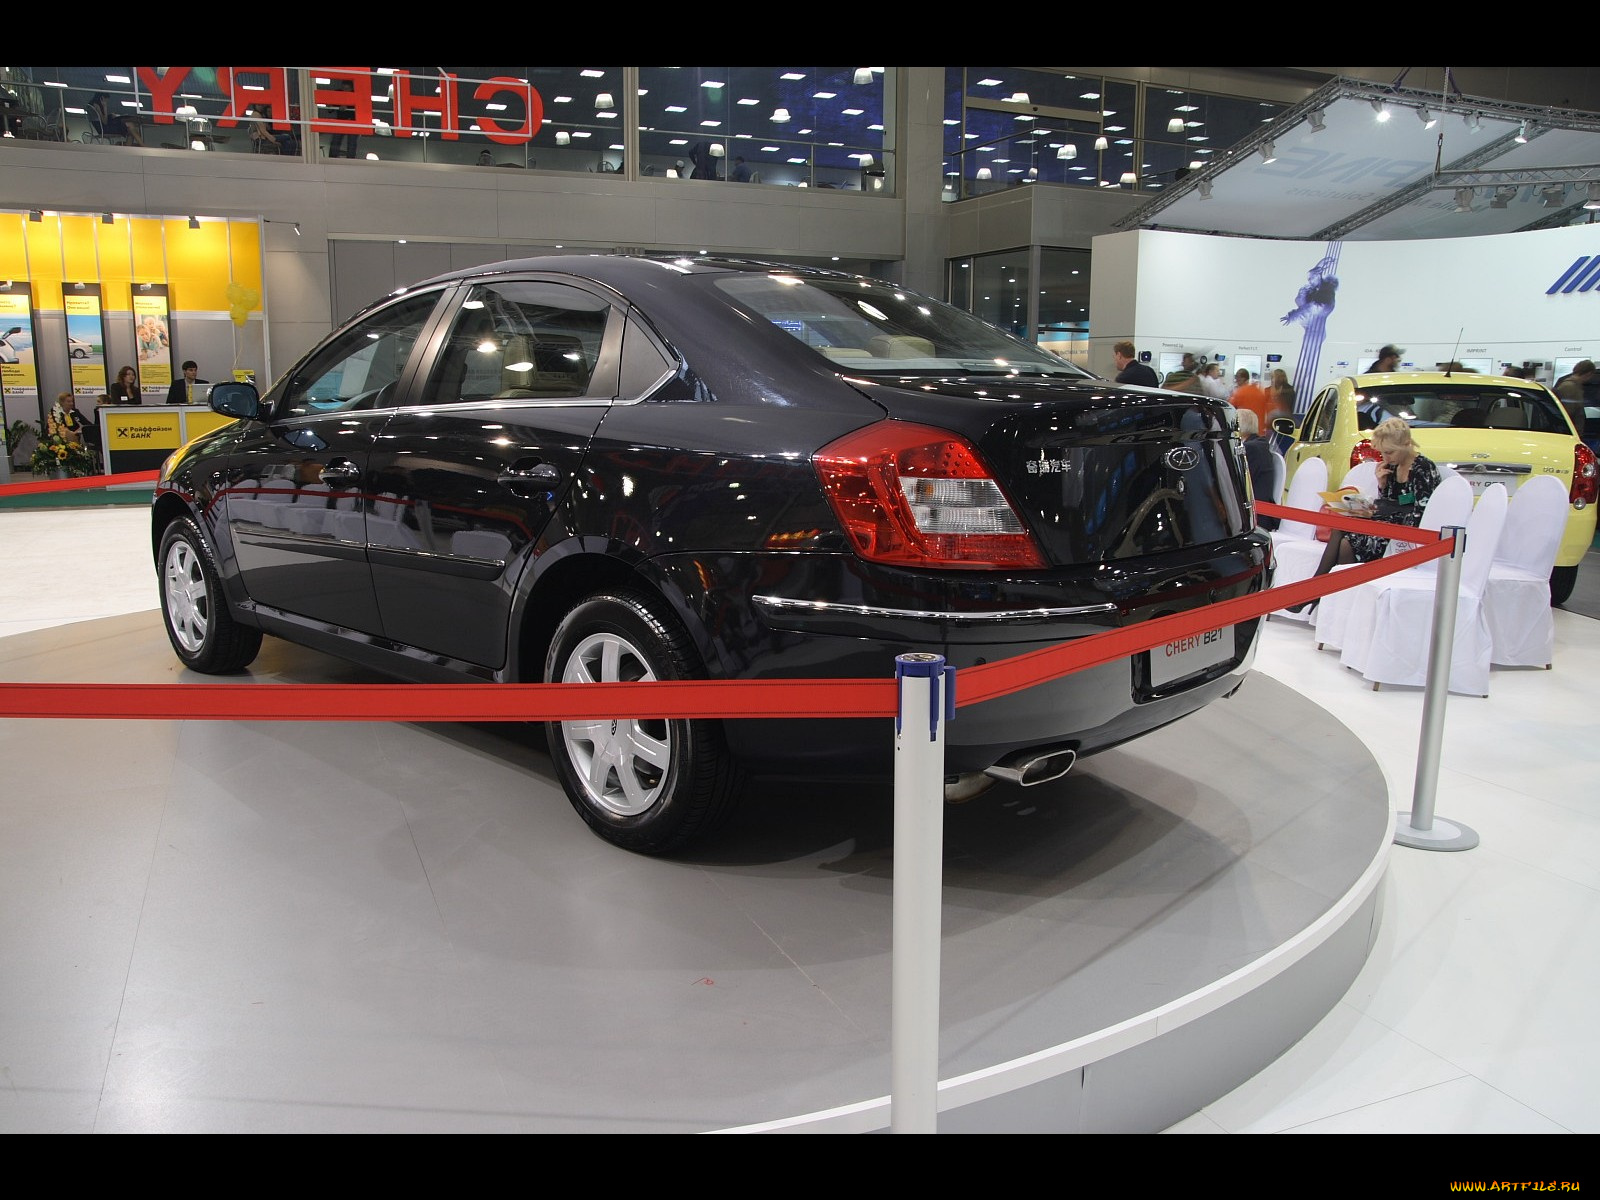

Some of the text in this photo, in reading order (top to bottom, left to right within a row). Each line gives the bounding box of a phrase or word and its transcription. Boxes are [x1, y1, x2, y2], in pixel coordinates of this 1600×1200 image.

[129, 426, 173, 434] Райффайзен
[1165, 628, 1223, 658] CHERY B21
